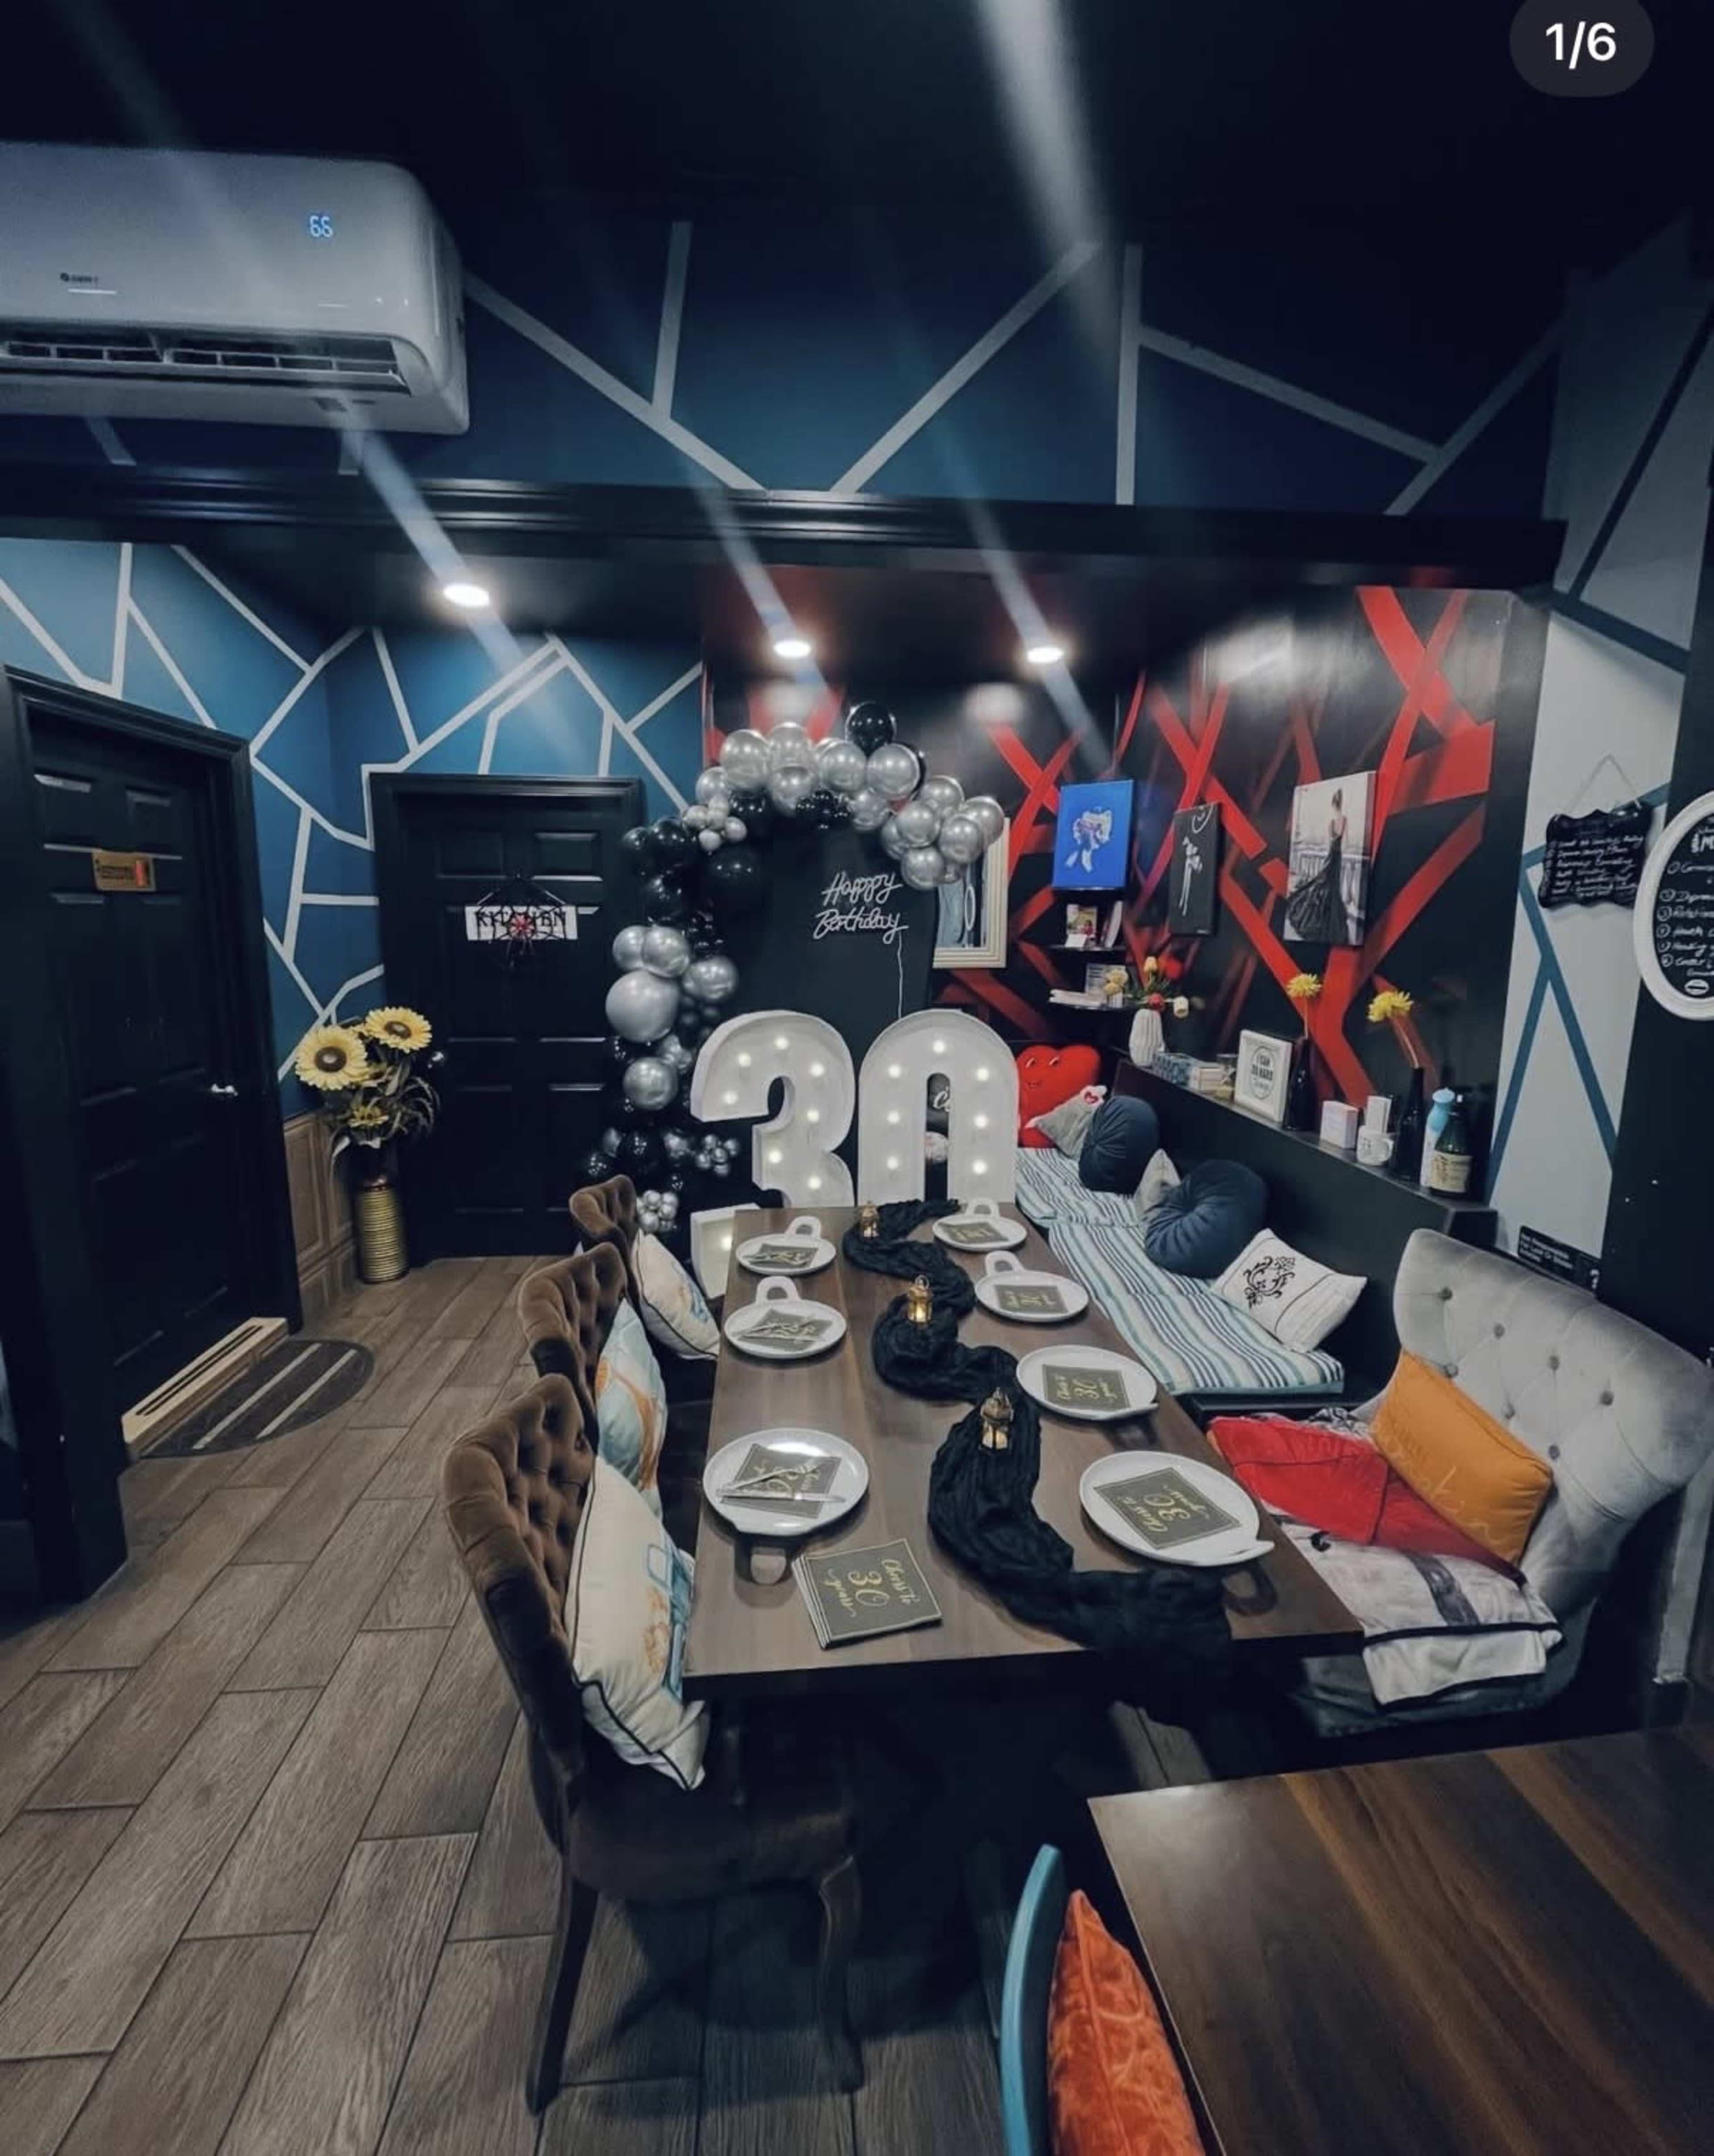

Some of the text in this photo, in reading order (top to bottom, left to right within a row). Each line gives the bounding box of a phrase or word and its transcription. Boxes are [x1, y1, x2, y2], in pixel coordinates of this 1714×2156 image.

[821, 871, 903, 906] Happy
[813, 906, 909, 945] Birthday
[1143, 1494, 1191, 1522] 30
[848, 1570, 890, 1607] 30
